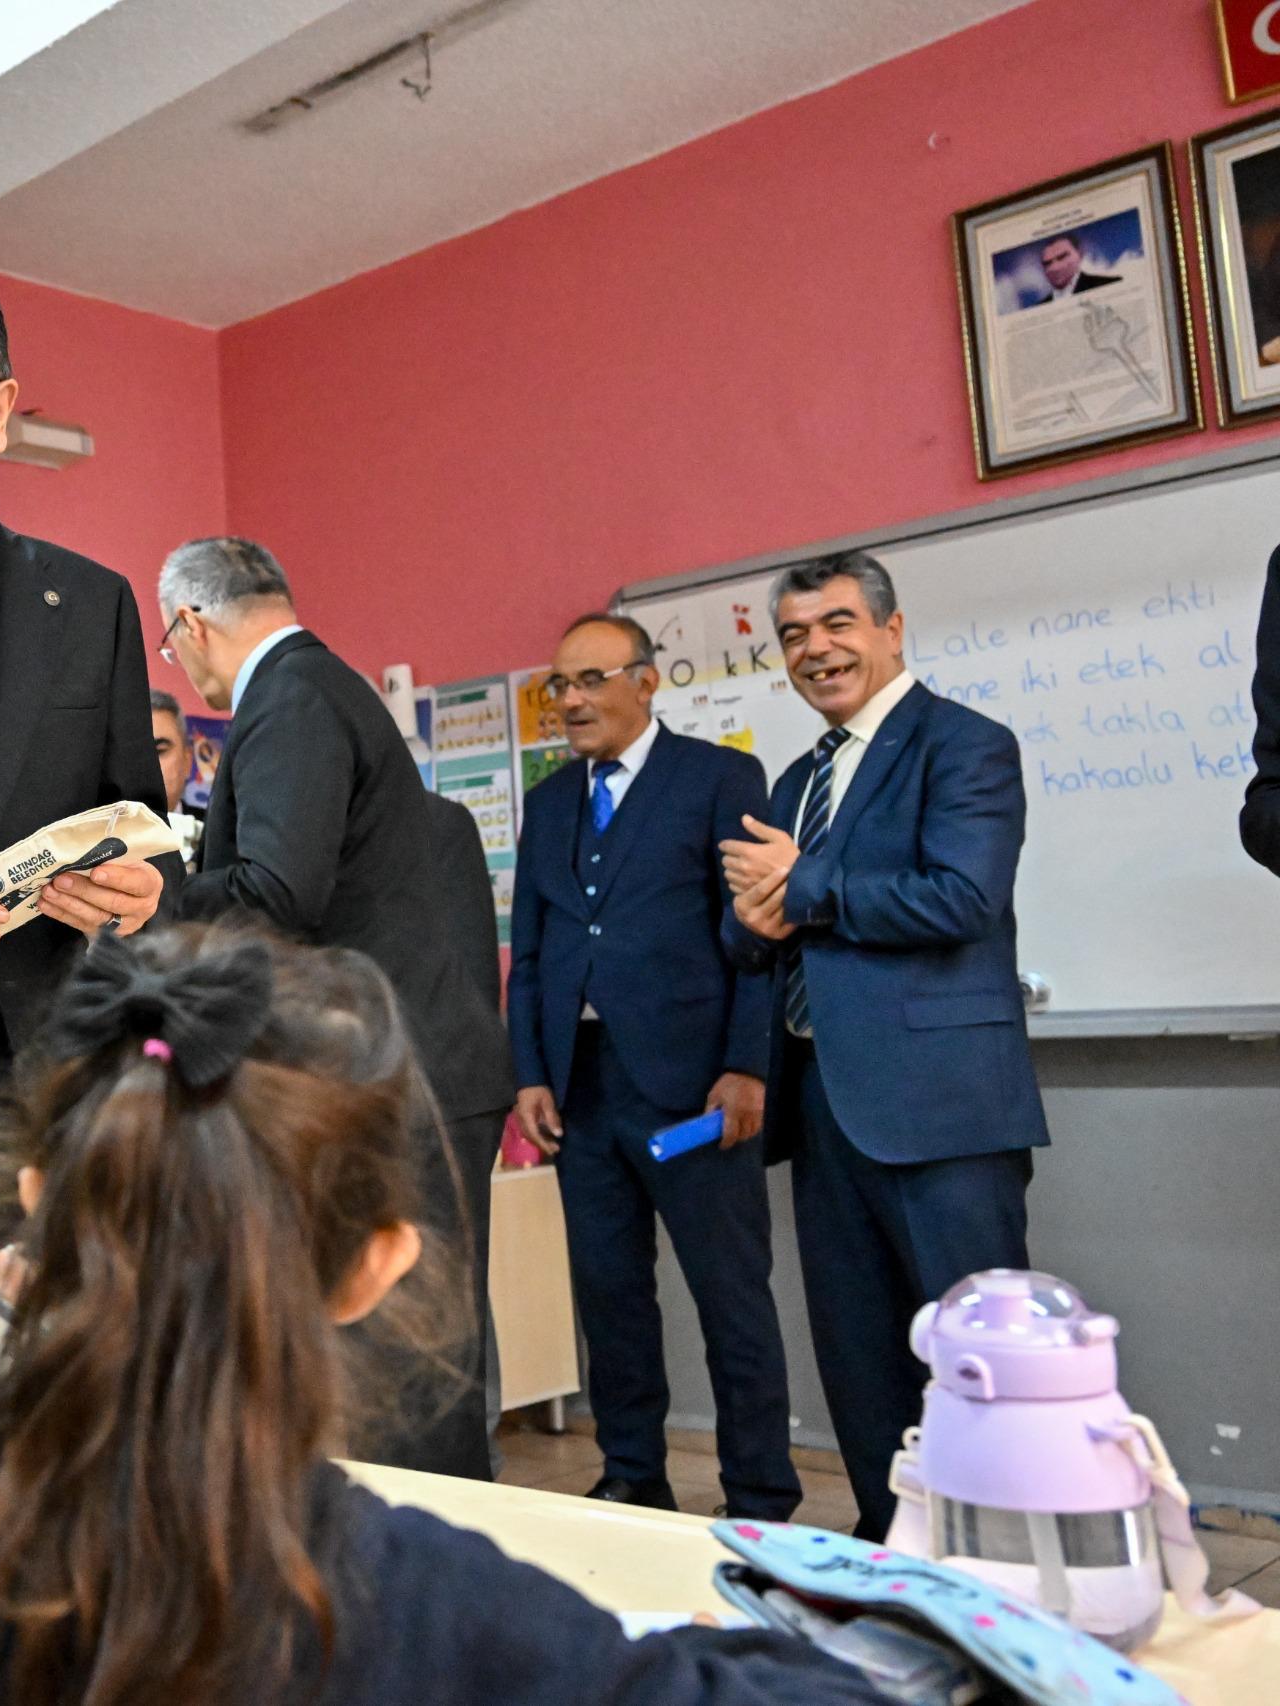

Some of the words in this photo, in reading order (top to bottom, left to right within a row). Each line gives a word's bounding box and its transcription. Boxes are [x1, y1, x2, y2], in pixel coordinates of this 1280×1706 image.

[911, 621, 1008, 662] Lale
[1030, 609, 1112, 638] nane
[1142, 580, 1215, 618] ekti
[1022, 658, 1057, 693] iki
[1079, 642, 1166, 684] etek
[1199, 629, 1242, 669] al
[1080, 699, 1185, 737] takla
[1207, 689, 1251, 727] at
